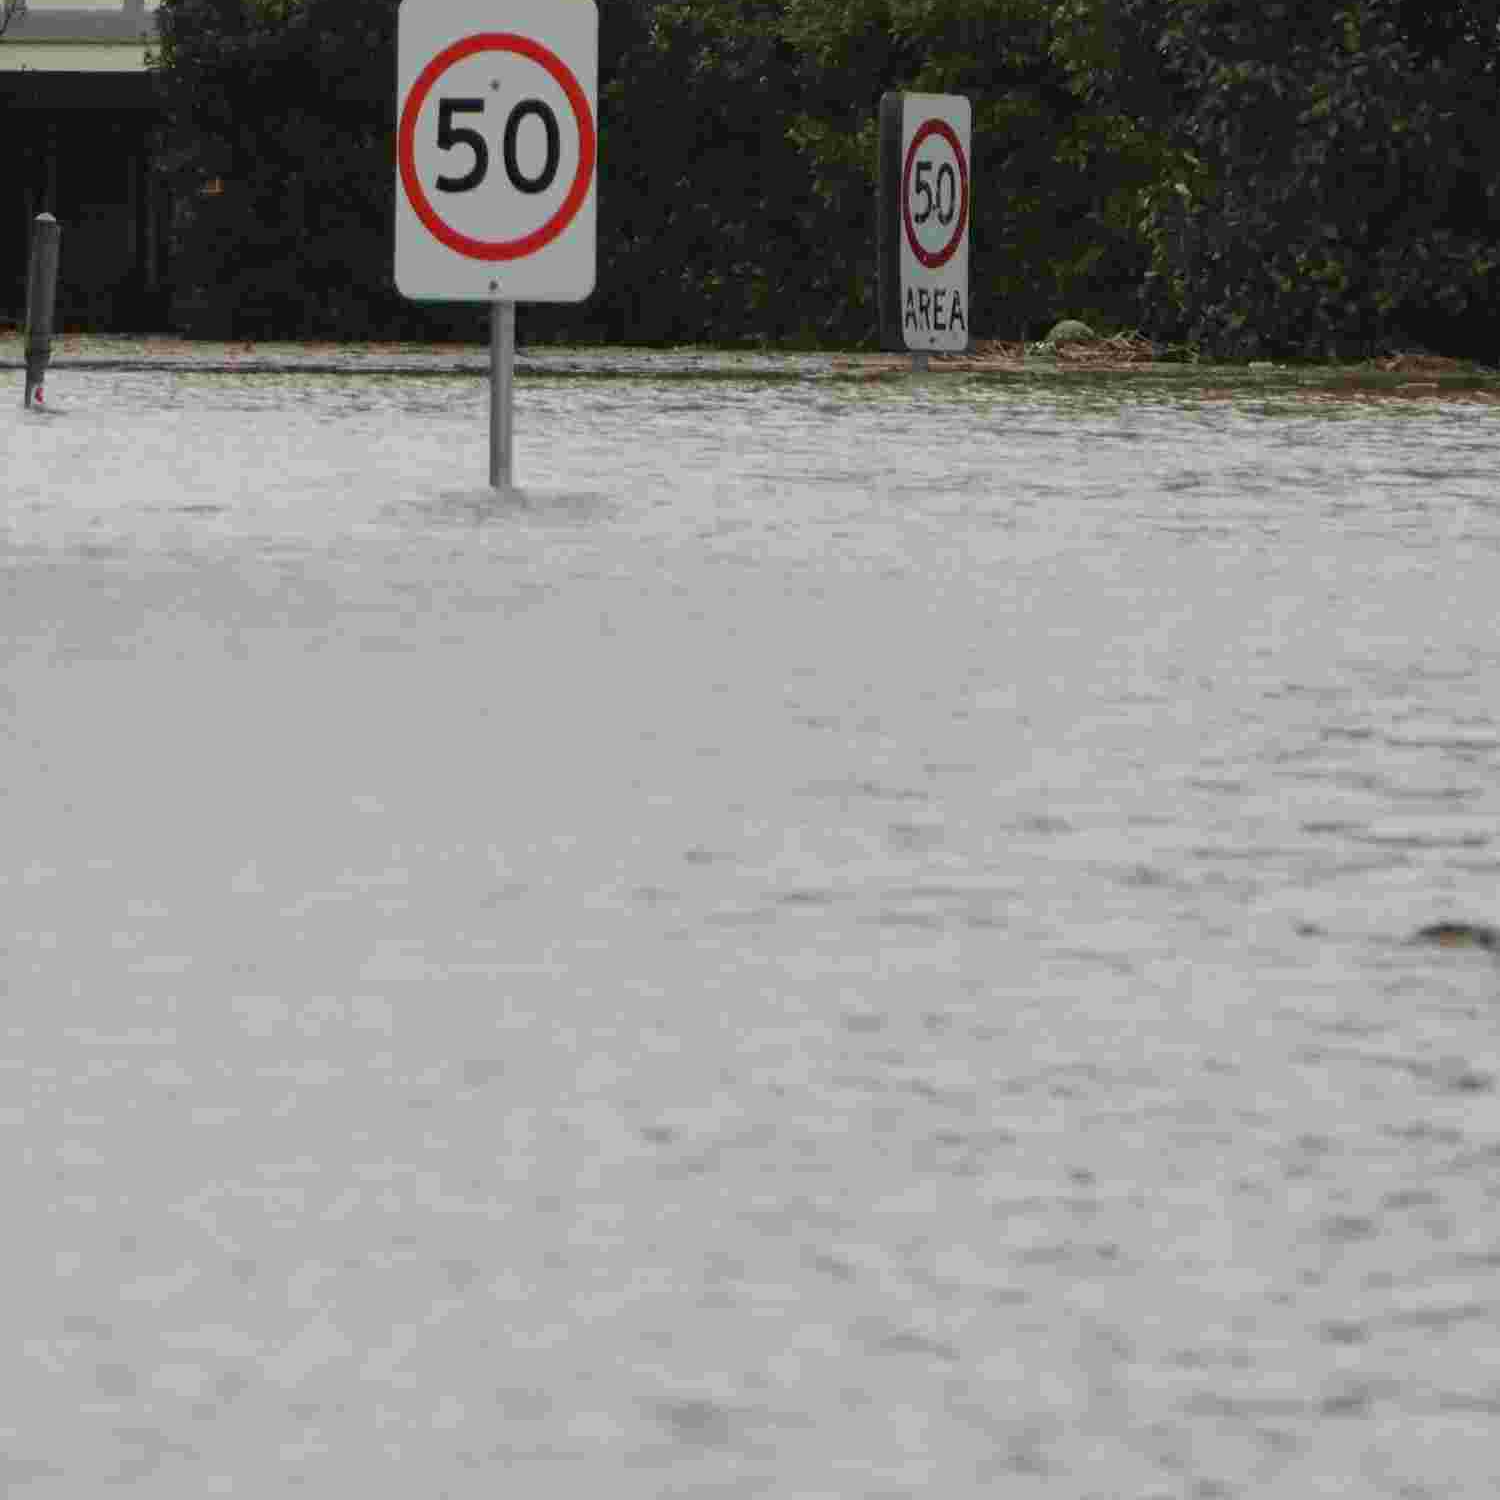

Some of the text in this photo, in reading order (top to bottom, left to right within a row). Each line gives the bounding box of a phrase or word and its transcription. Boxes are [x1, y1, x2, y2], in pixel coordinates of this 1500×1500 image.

[435, 97, 560, 195] 50
[914, 160, 956, 226] 50
[904, 287, 966, 331] AREA
